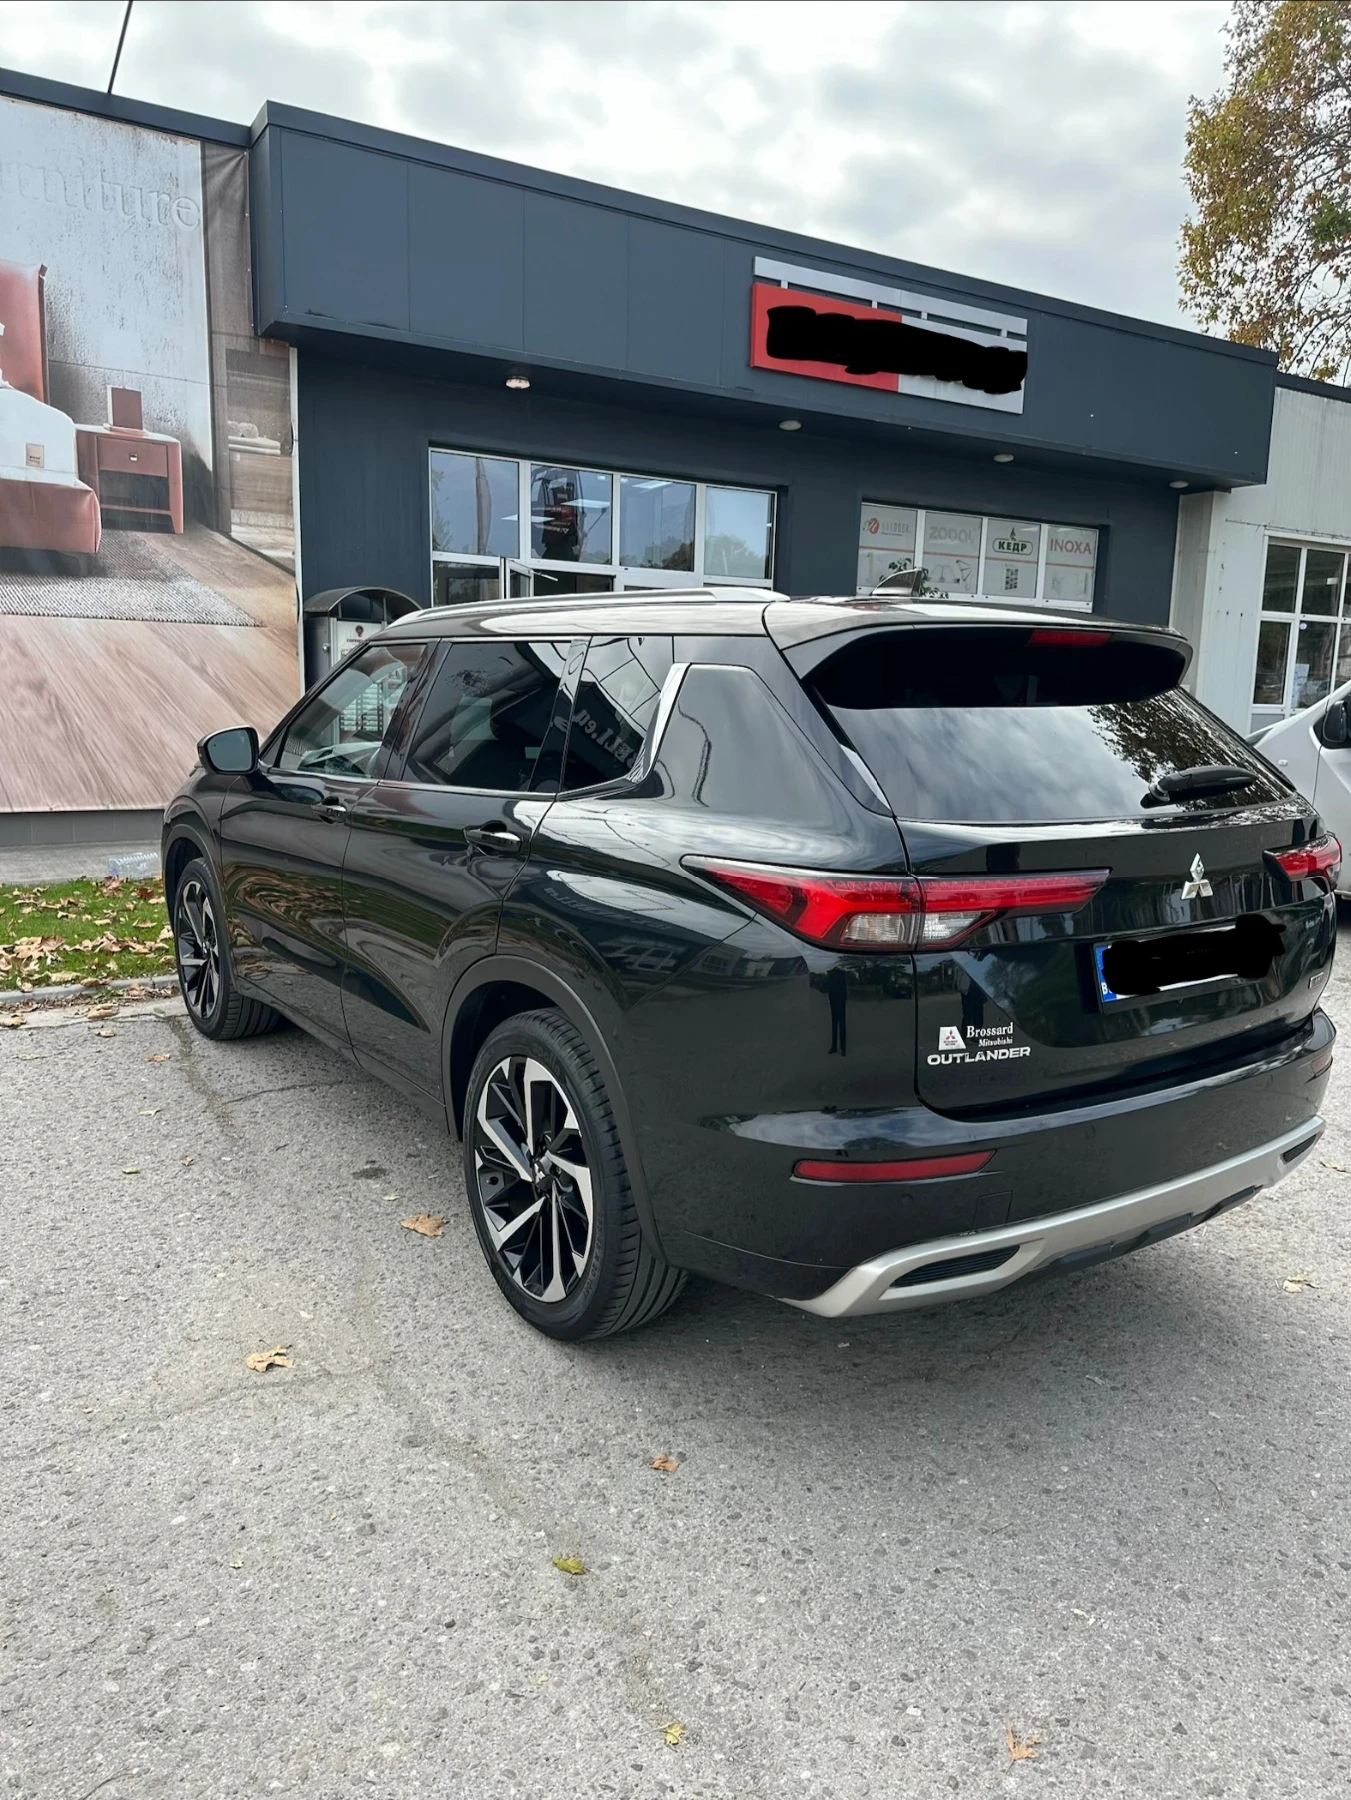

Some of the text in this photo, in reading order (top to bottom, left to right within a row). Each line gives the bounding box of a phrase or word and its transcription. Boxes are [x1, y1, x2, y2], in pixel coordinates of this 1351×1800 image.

[998, 541, 1028, 553] КЕДР
[1050, 539, 1092, 555] INOXA
[966, 1021, 1014, 1038] Brossard
[978, 1036, 1013, 1047] Mitsubishi
[926, 1046, 1031, 1066] OUTLANDER
